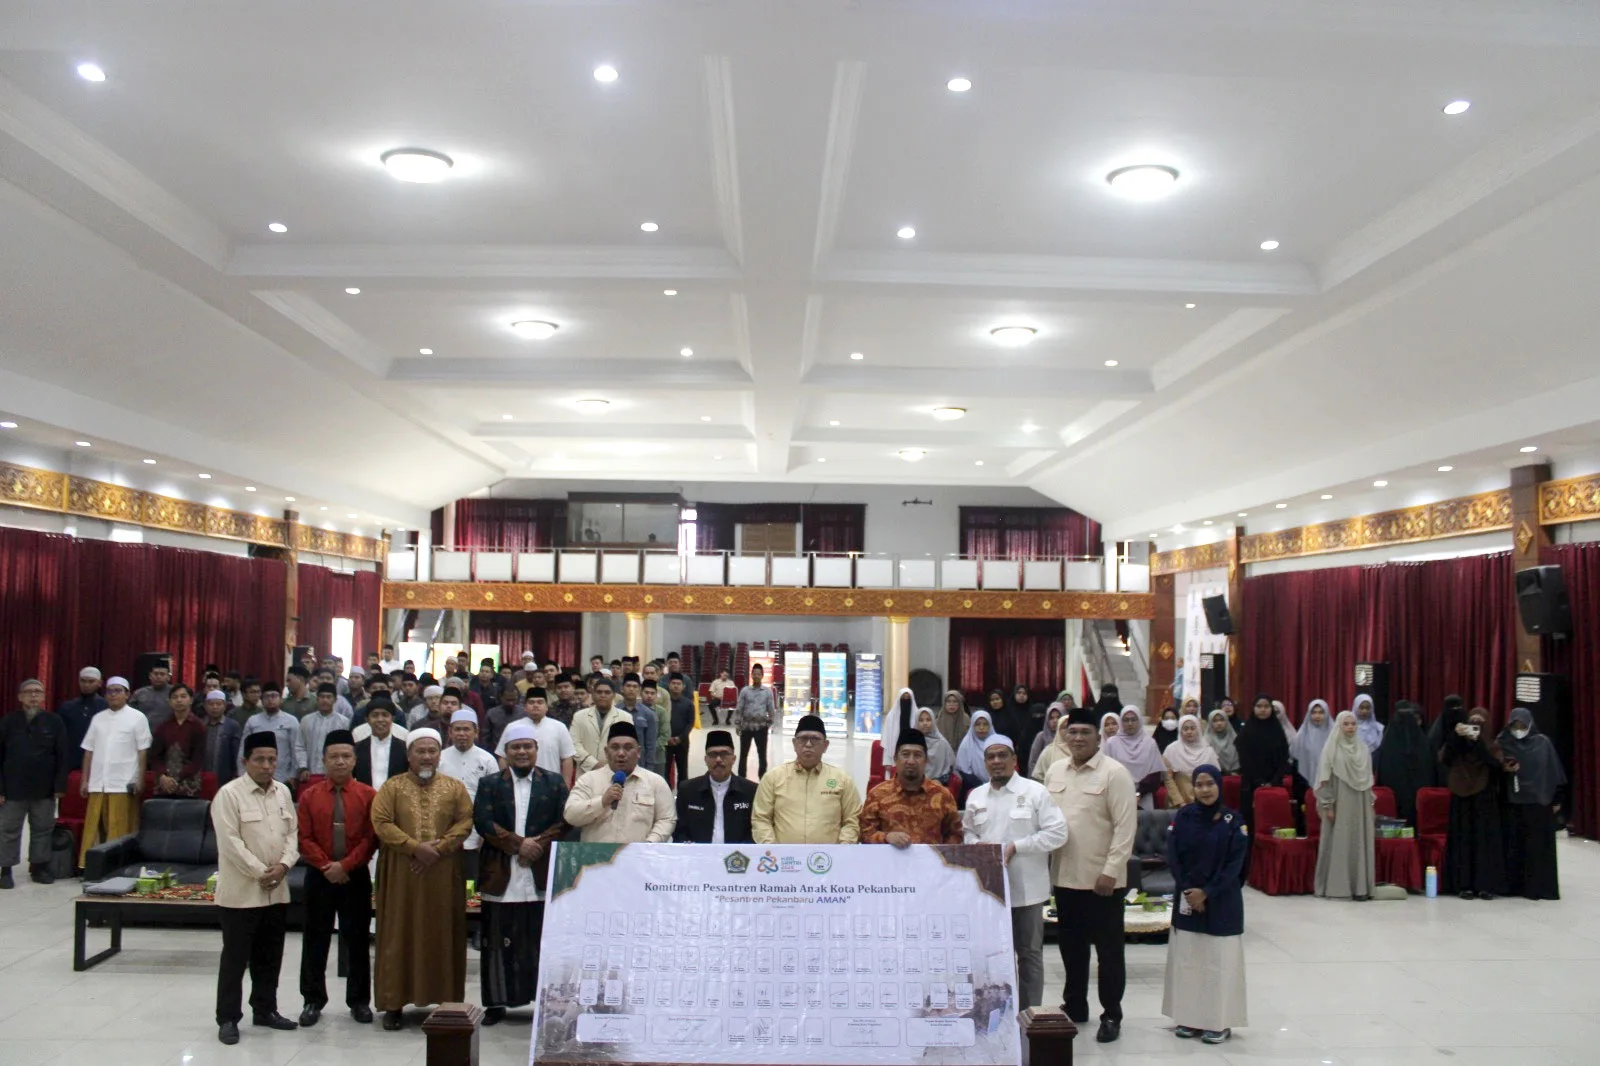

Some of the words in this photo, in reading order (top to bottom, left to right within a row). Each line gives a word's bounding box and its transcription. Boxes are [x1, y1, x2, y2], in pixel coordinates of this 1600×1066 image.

[644, 882, 700, 892] Komitmen
[703, 883, 757, 892] Pesantren
[759, 883, 797, 893] Ramah
[799, 884, 828, 893] Anak
[830, 884, 855, 893] Kota
[857, 884, 916, 894] Pekanbaru
[766, 895, 814, 903] Pekanbaru
